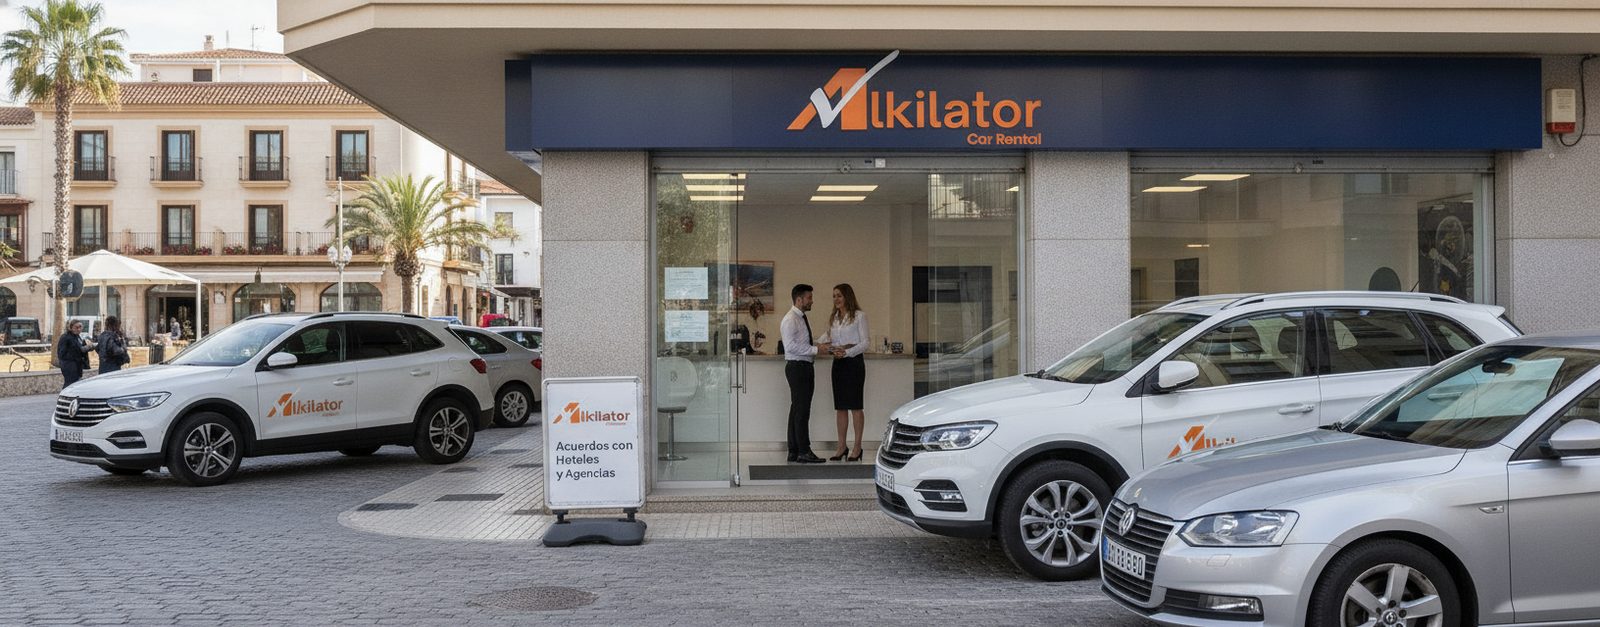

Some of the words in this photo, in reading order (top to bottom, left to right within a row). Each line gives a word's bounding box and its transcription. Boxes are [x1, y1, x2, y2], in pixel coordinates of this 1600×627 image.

[787, 67, 1042, 131] Alkilator
[967, 132, 992, 146] Car
[996, 132, 1042, 146] Rental
[556, 441, 609, 451] Acuerdos
[612, 442, 633, 450] con
[556, 471, 564, 482] y
[565, 468, 615, 480] Agencias
